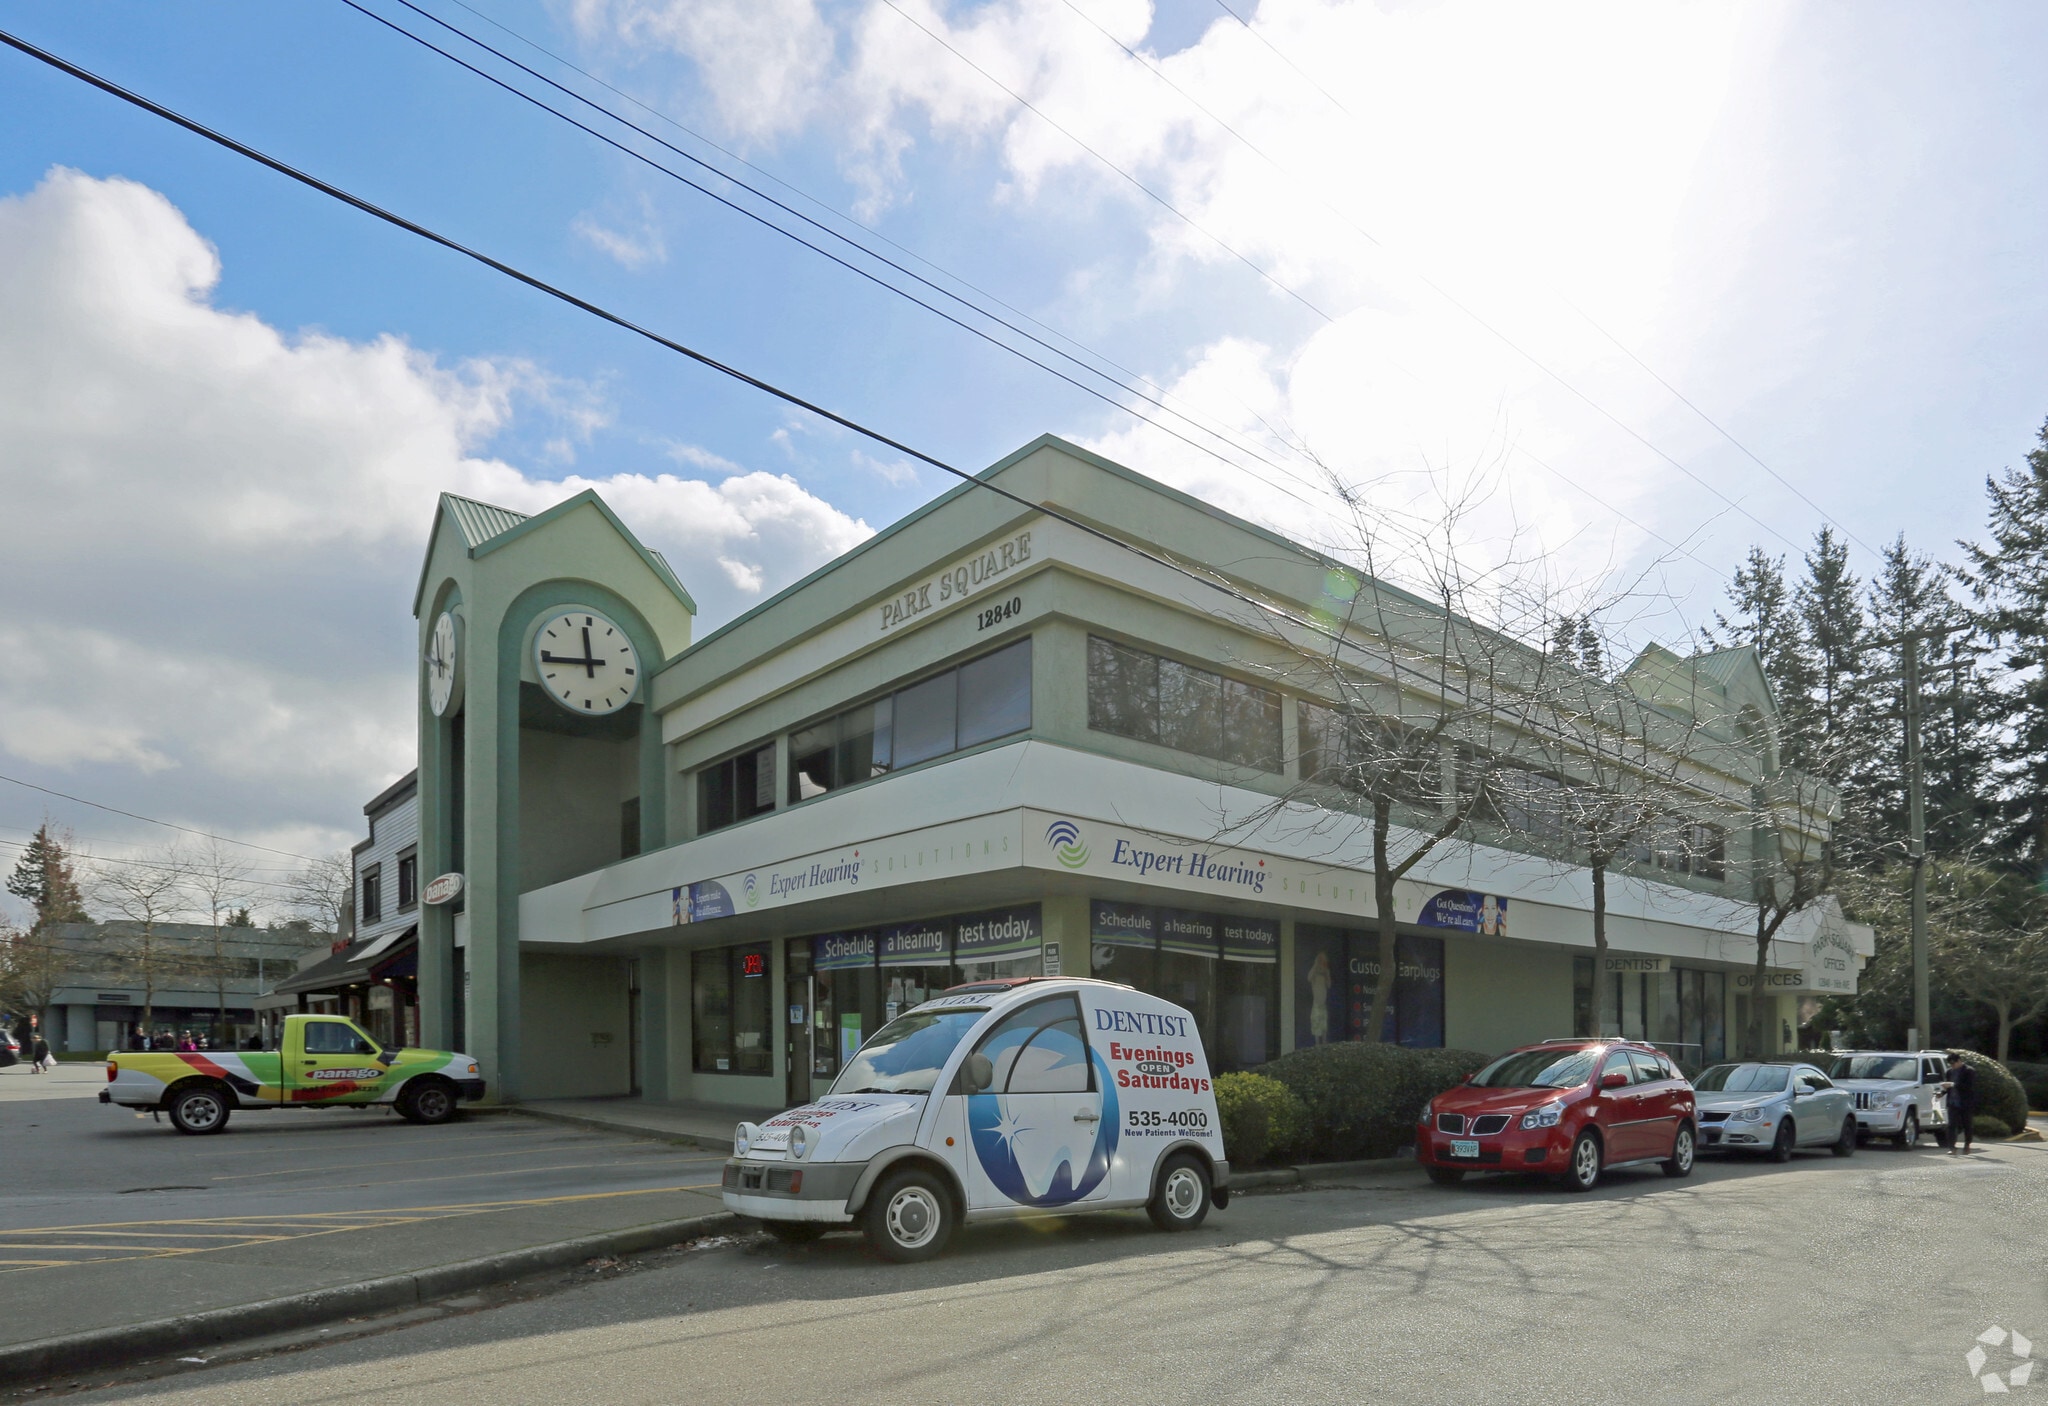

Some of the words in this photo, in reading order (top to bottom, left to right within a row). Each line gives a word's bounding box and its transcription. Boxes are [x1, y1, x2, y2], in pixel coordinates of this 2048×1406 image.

[881, 582, 932, 630] PARK
[940, 532, 1031, 601] SQUARE
[977, 597, 1022, 631] 12840
[875, 836, 1008, 874] SOLUTIONS
[1111, 839, 1183, 875] Expert
[1188, 853, 1266, 893] Hearing
[427, 873, 460, 903] panago
[770, 869, 806, 898] Expert
[809, 858, 860, 885] Hearing
[1283, 878, 1412, 910] SOLUTINS
[1436, 898, 1448, 908] Got
[825, 934, 874, 957] Schedule
[888, 937, 894, 951] a
[897, 928, 943, 952] hearing
[959, 920, 984, 943] test
[988, 915, 1033, 942] today.
[1100, 912, 1151, 930] Schedule
[1164, 921, 1171, 931] a
[1173, 919, 1213, 938] hearing
[1225, 926, 1243, 939] test
[1245, 927, 1274, 943] today.
[1349, 958, 1381, 975] Custo
[1604, 958, 1662, 971] DENTIST
[1094, 1008, 1187, 1037] DENTIST
[1110, 1042, 1194, 1068] Evenings
[1141, 1063, 1170, 1073] OPEN
[312, 1068, 379, 1080] panago
[1117, 1069, 1209, 1094] Saturdays
[1125, 1129, 1143, 1137] New
[1145, 1129, 1176, 1137] Patients
[1178, 1129, 1213, 1138] Welcome!
[1129, 1110, 1208, 1128] 535-4000
